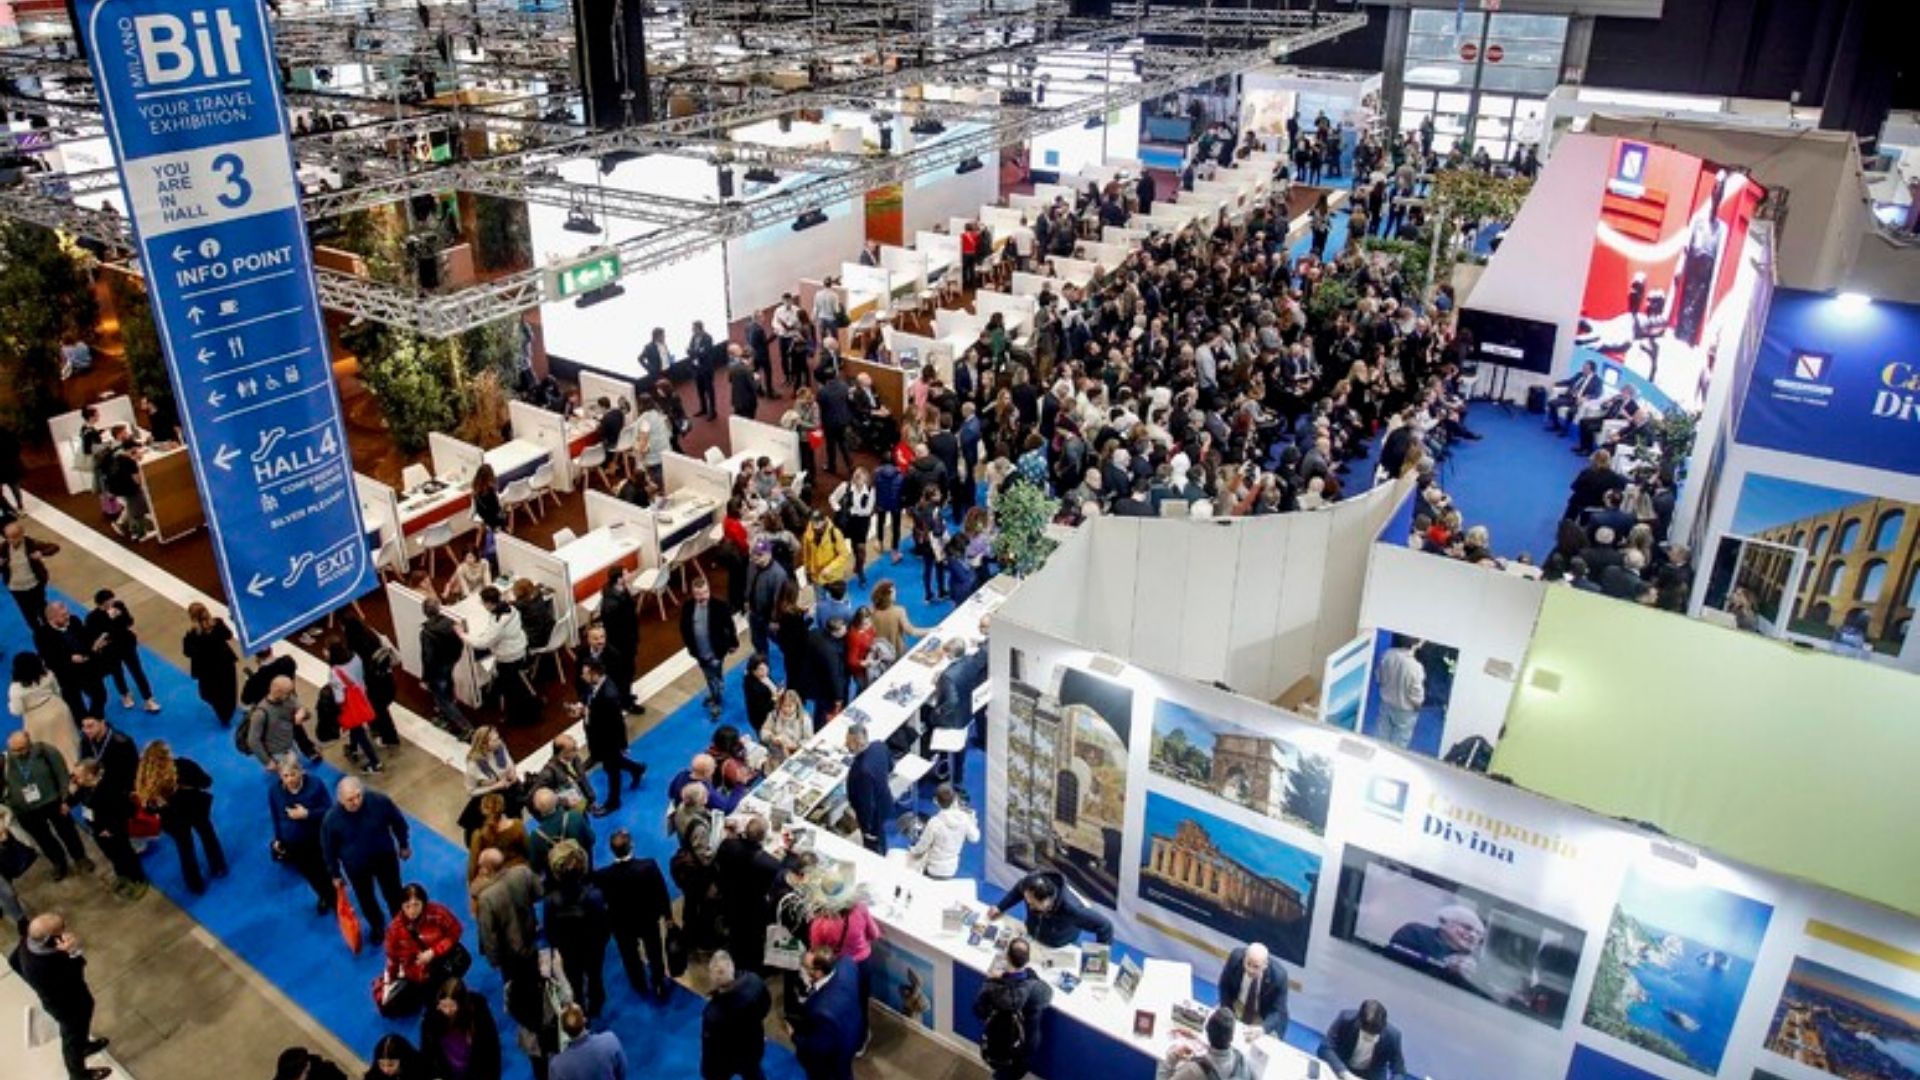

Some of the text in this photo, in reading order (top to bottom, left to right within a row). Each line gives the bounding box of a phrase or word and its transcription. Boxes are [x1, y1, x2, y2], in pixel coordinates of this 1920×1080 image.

[118, 17, 144, 88] MILANO
[134, 8, 242, 84] Bit
[139, 91, 255, 119] YOUR TRAVEL
[150, 108, 251, 135] EXHIBITION.
[152, 161, 190, 178] YOU
[157, 176, 192, 193] ARE
[211, 153, 252, 209] 3
[159, 194, 177, 208] IN
[163, 204, 208, 223] HALL
[176, 245, 292, 288] INFO POINT
[316, 543, 356, 579] EXIT
[1422, 813, 1516, 864] Divina
